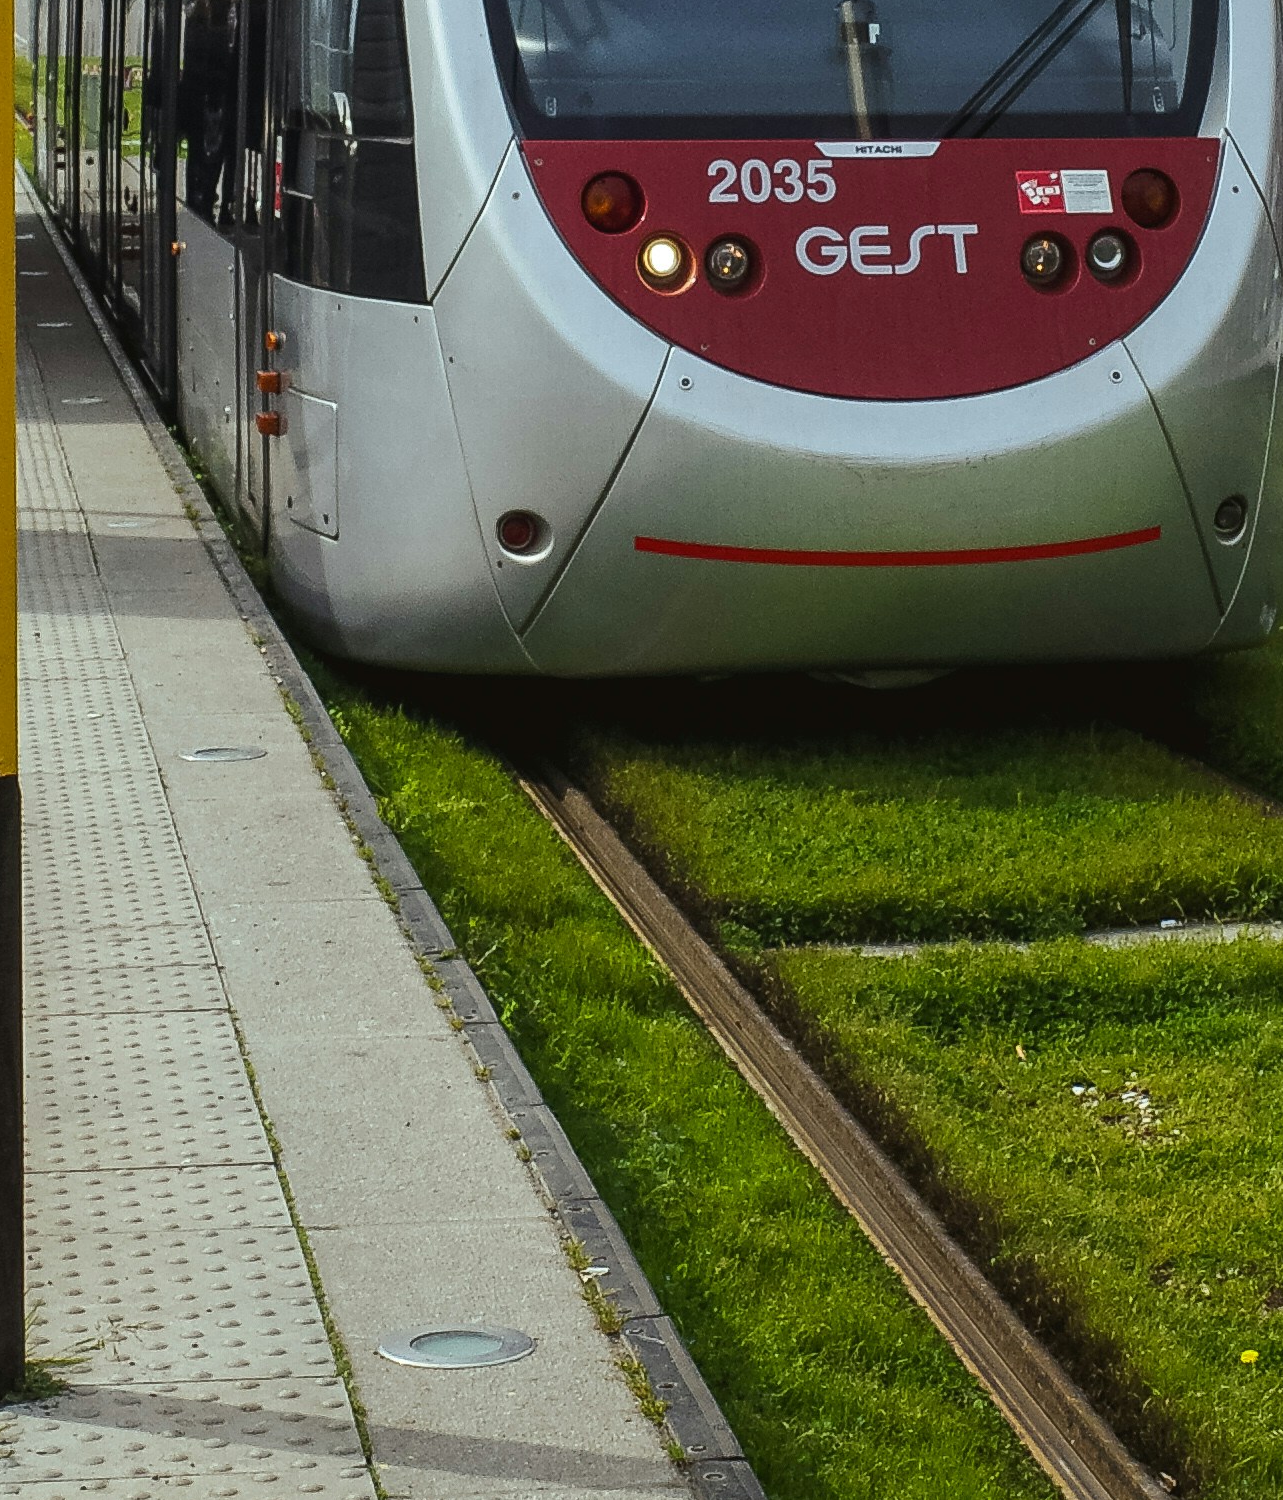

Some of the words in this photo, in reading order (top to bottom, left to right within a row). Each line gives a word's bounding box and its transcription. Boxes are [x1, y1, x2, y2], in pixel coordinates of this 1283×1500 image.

[854, 144, 904, 155] HITACHI
[707, 158, 838, 203] 2035
[795, 223, 980, 276] GEST
